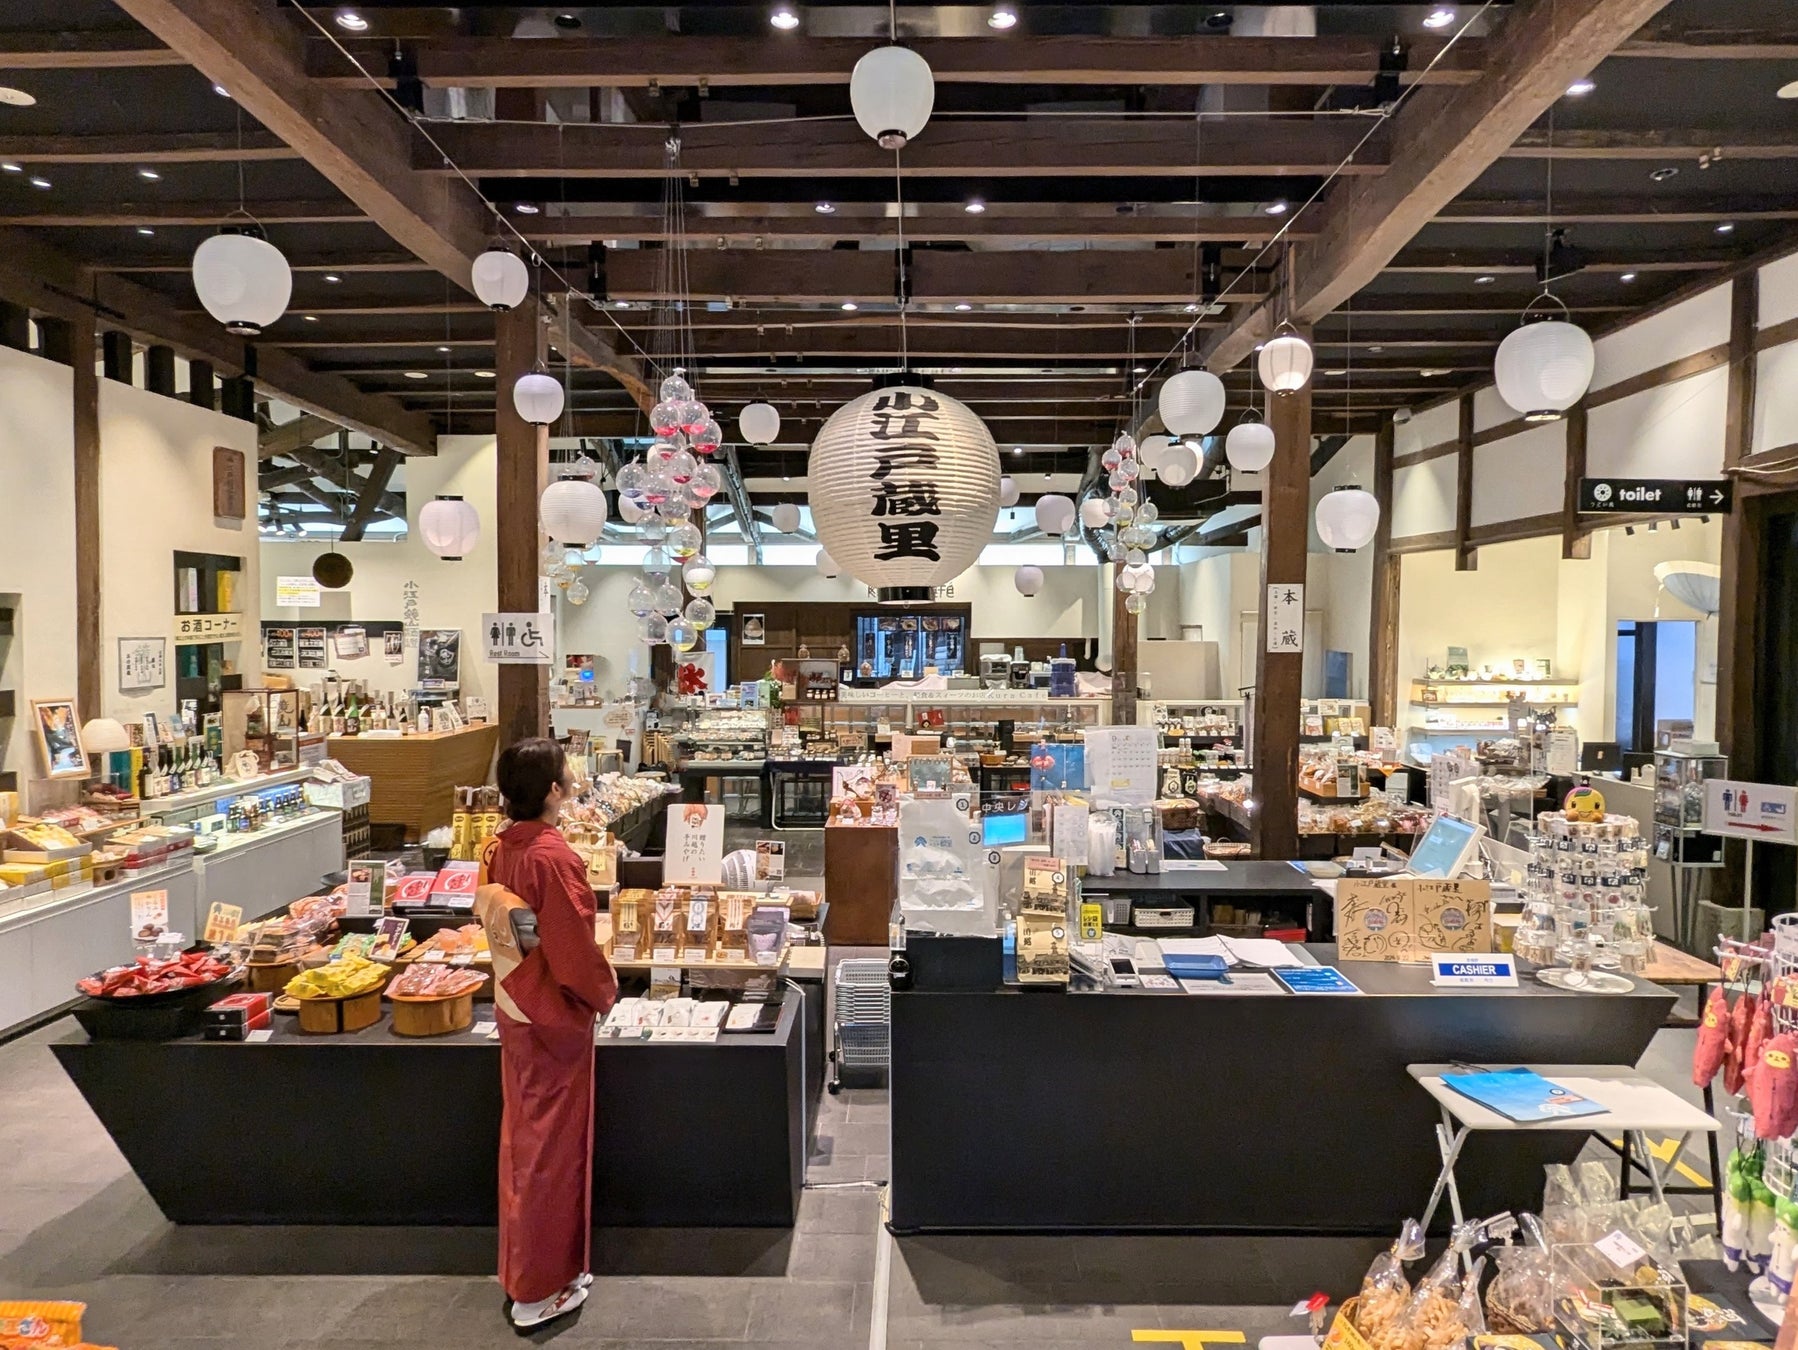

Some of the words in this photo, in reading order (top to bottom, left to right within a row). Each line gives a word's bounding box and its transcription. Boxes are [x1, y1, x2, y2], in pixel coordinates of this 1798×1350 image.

[869, 391, 942, 563] 小江戸蔵里
[1619, 486, 1662, 501] toilet
[180, 618, 237, 633] お酒コーナー
[981, 801, 1019, 814] 中央レ
[1452, 964, 1497, 975] CASHIER
